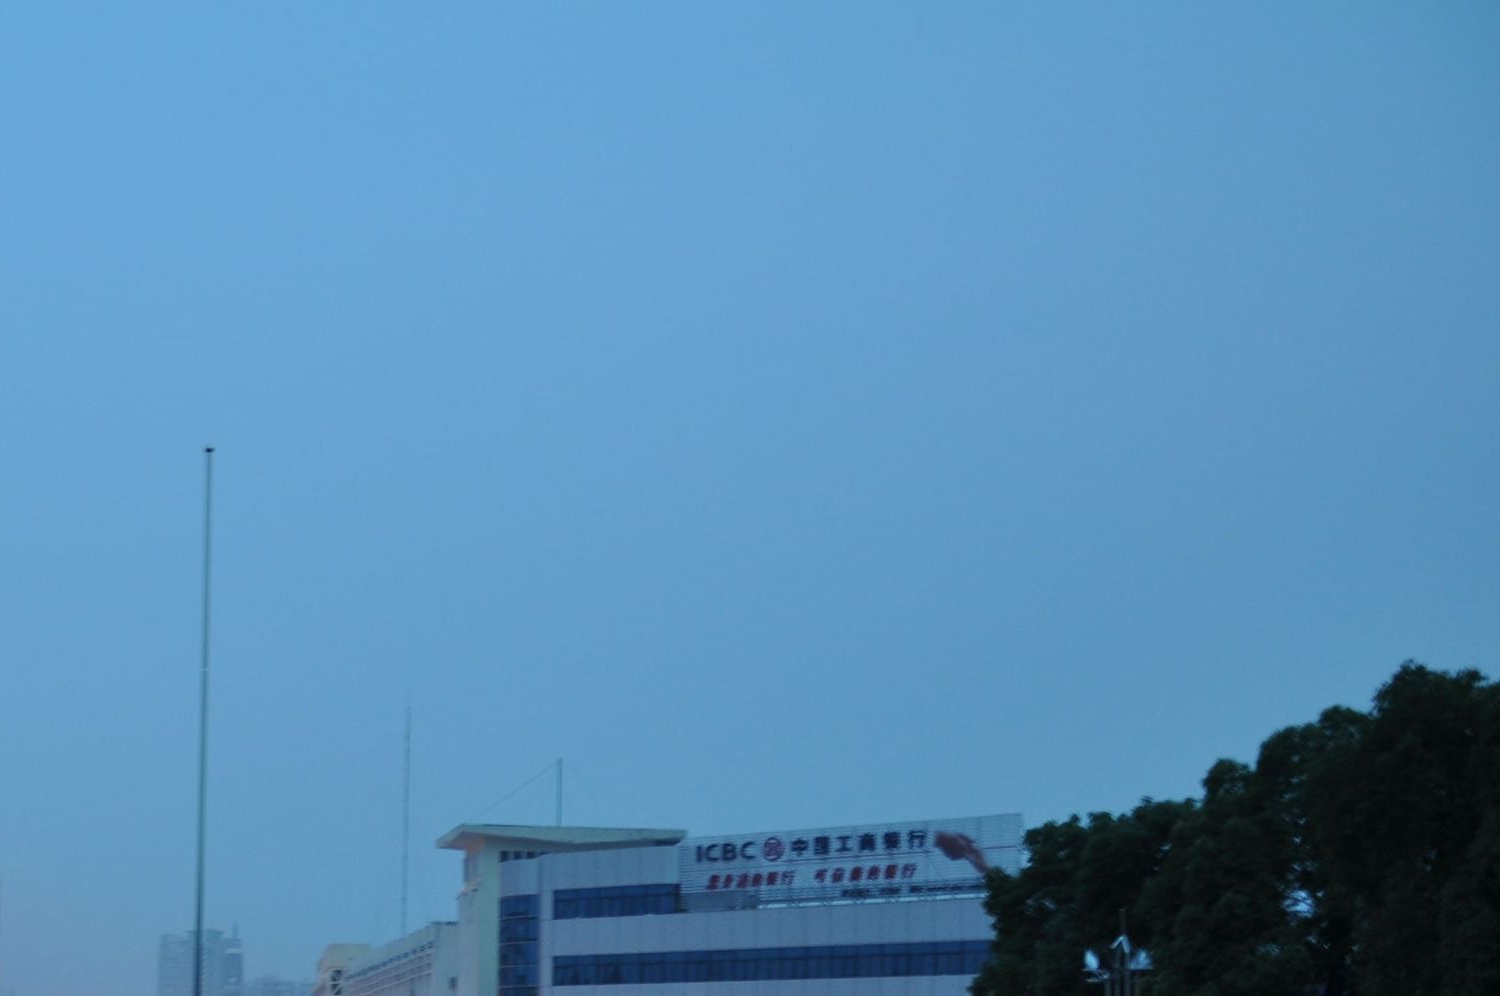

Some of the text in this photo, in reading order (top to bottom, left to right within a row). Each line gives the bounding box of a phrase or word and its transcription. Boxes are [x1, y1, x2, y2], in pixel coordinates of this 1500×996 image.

[695, 840, 757, 863] ICBC
[790, 830, 929, 857] 中国工商银行
